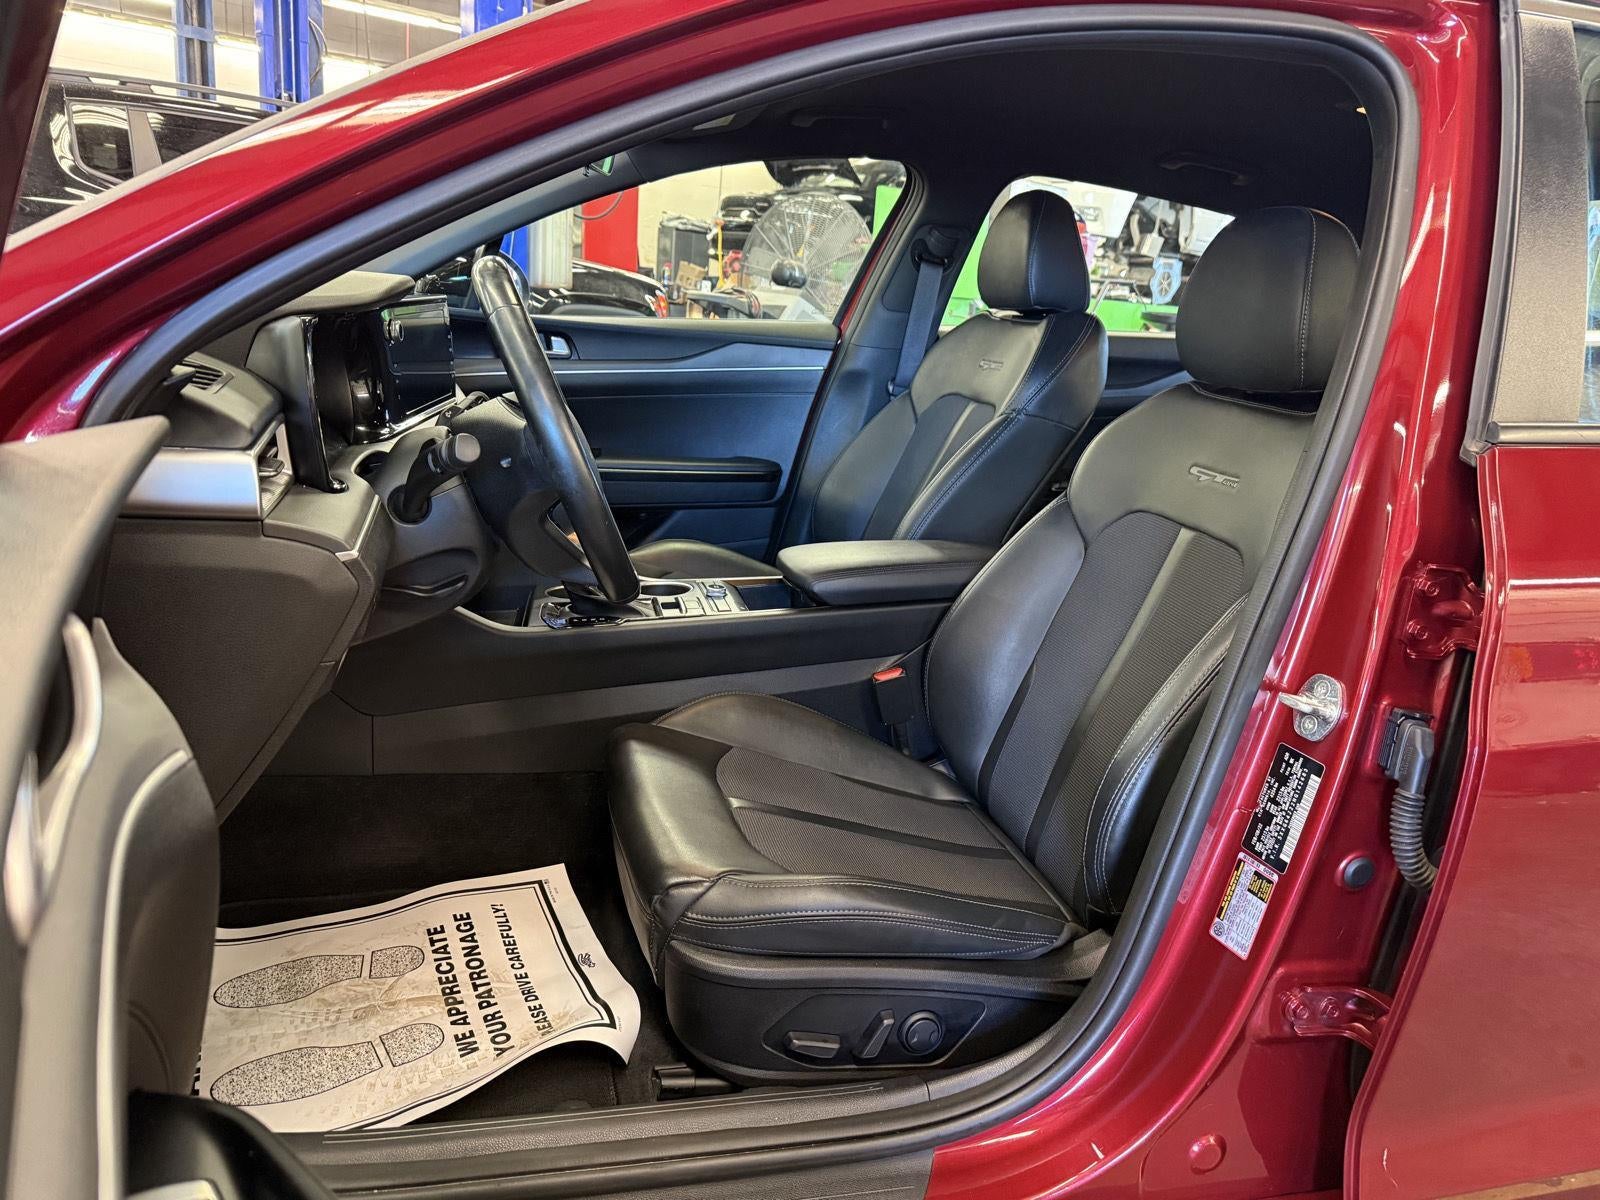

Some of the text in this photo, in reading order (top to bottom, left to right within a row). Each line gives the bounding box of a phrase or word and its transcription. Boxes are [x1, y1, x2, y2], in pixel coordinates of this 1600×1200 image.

[453, 911, 515, 1057] YOUR PATRONAGE
[490, 903, 525, 970] CAREFULLY!
[426, 924, 480, 1058] WE APPRECIATE
[514, 972, 539, 1003] DRIVE
